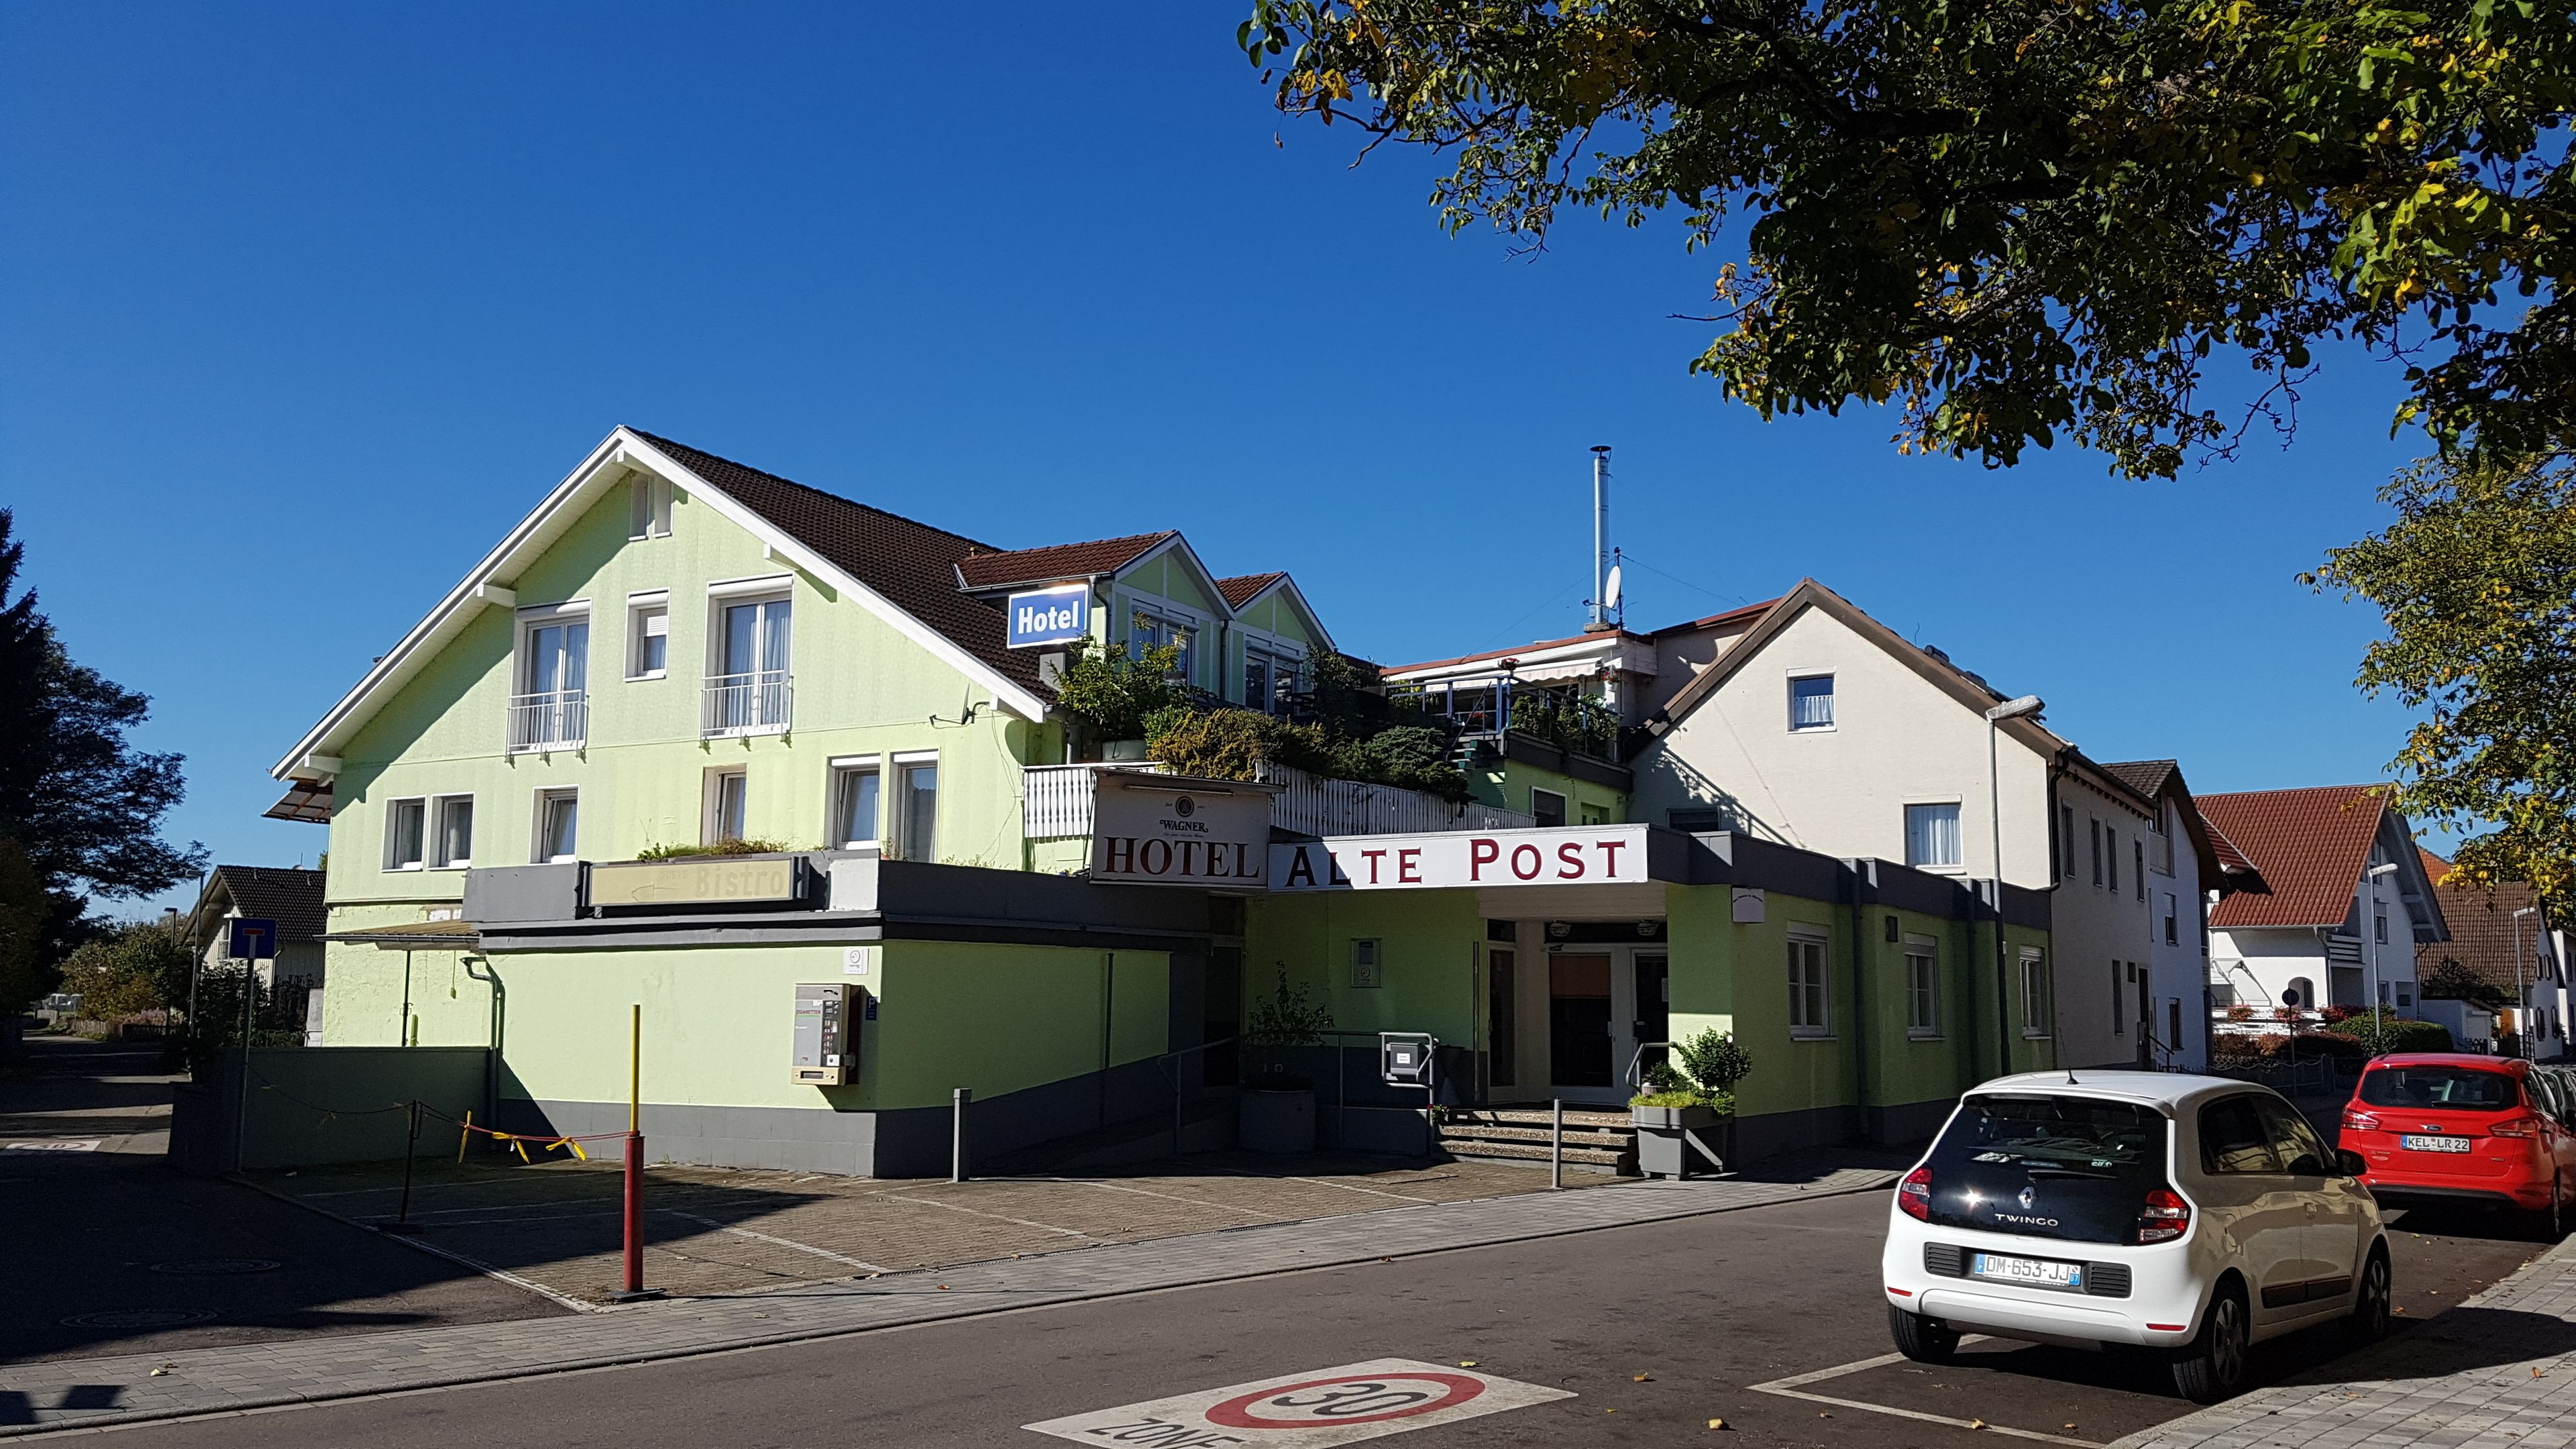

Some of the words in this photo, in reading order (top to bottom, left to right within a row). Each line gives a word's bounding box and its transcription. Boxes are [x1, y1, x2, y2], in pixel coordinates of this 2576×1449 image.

[1018, 600, 1079, 634] Hotel
[1159, 819, 1209, 833] WAGNER
[1102, 836, 1260, 878] HOTEL
[1284, 845, 1422, 888] ALTE
[1469, 838, 1627, 882] POST
[696, 864, 784, 898] Bistro
[868, 998, 875, 1009] P
[2408, 1137, 2430, 1148] KEL
[2437, 1139, 2452, 1149] LR
[2454, 1140, 2468, 1150] 22
[1994, 1214, 2059, 1227] TWINGO
[1986, 1256, 2070, 1281] DM-653-JJ
[2070, 1274, 2079, 1283] 67
[1271, 1383, 1429, 1415] 30
